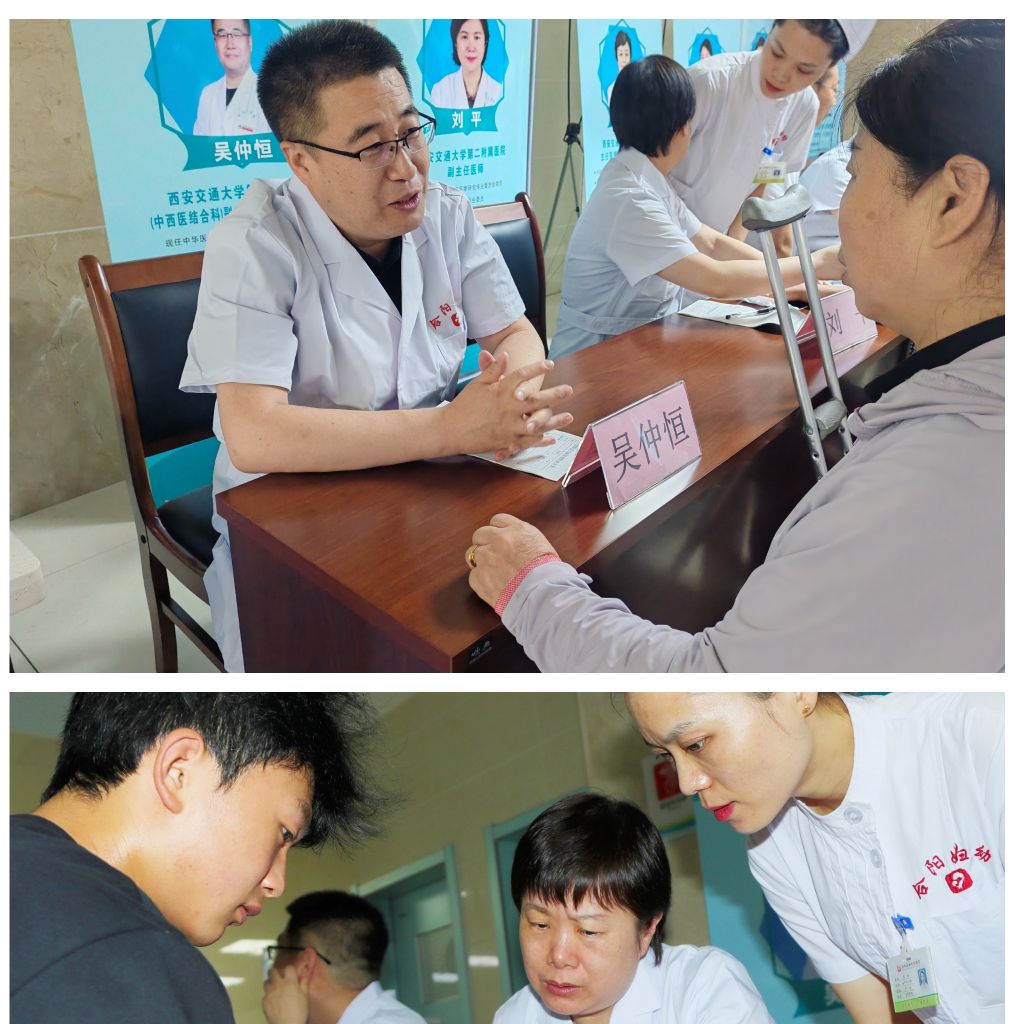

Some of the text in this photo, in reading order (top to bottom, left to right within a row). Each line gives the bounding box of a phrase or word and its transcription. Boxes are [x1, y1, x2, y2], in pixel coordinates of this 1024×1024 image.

[452, 111, 482, 128] 刘平
[214, 138, 274, 162] 吴仲恒
[447, 163, 484, 178] 副主任医师
[167, 184, 250, 206] 西安交通大学
[611, 406, 690, 483] 吴仲恒
